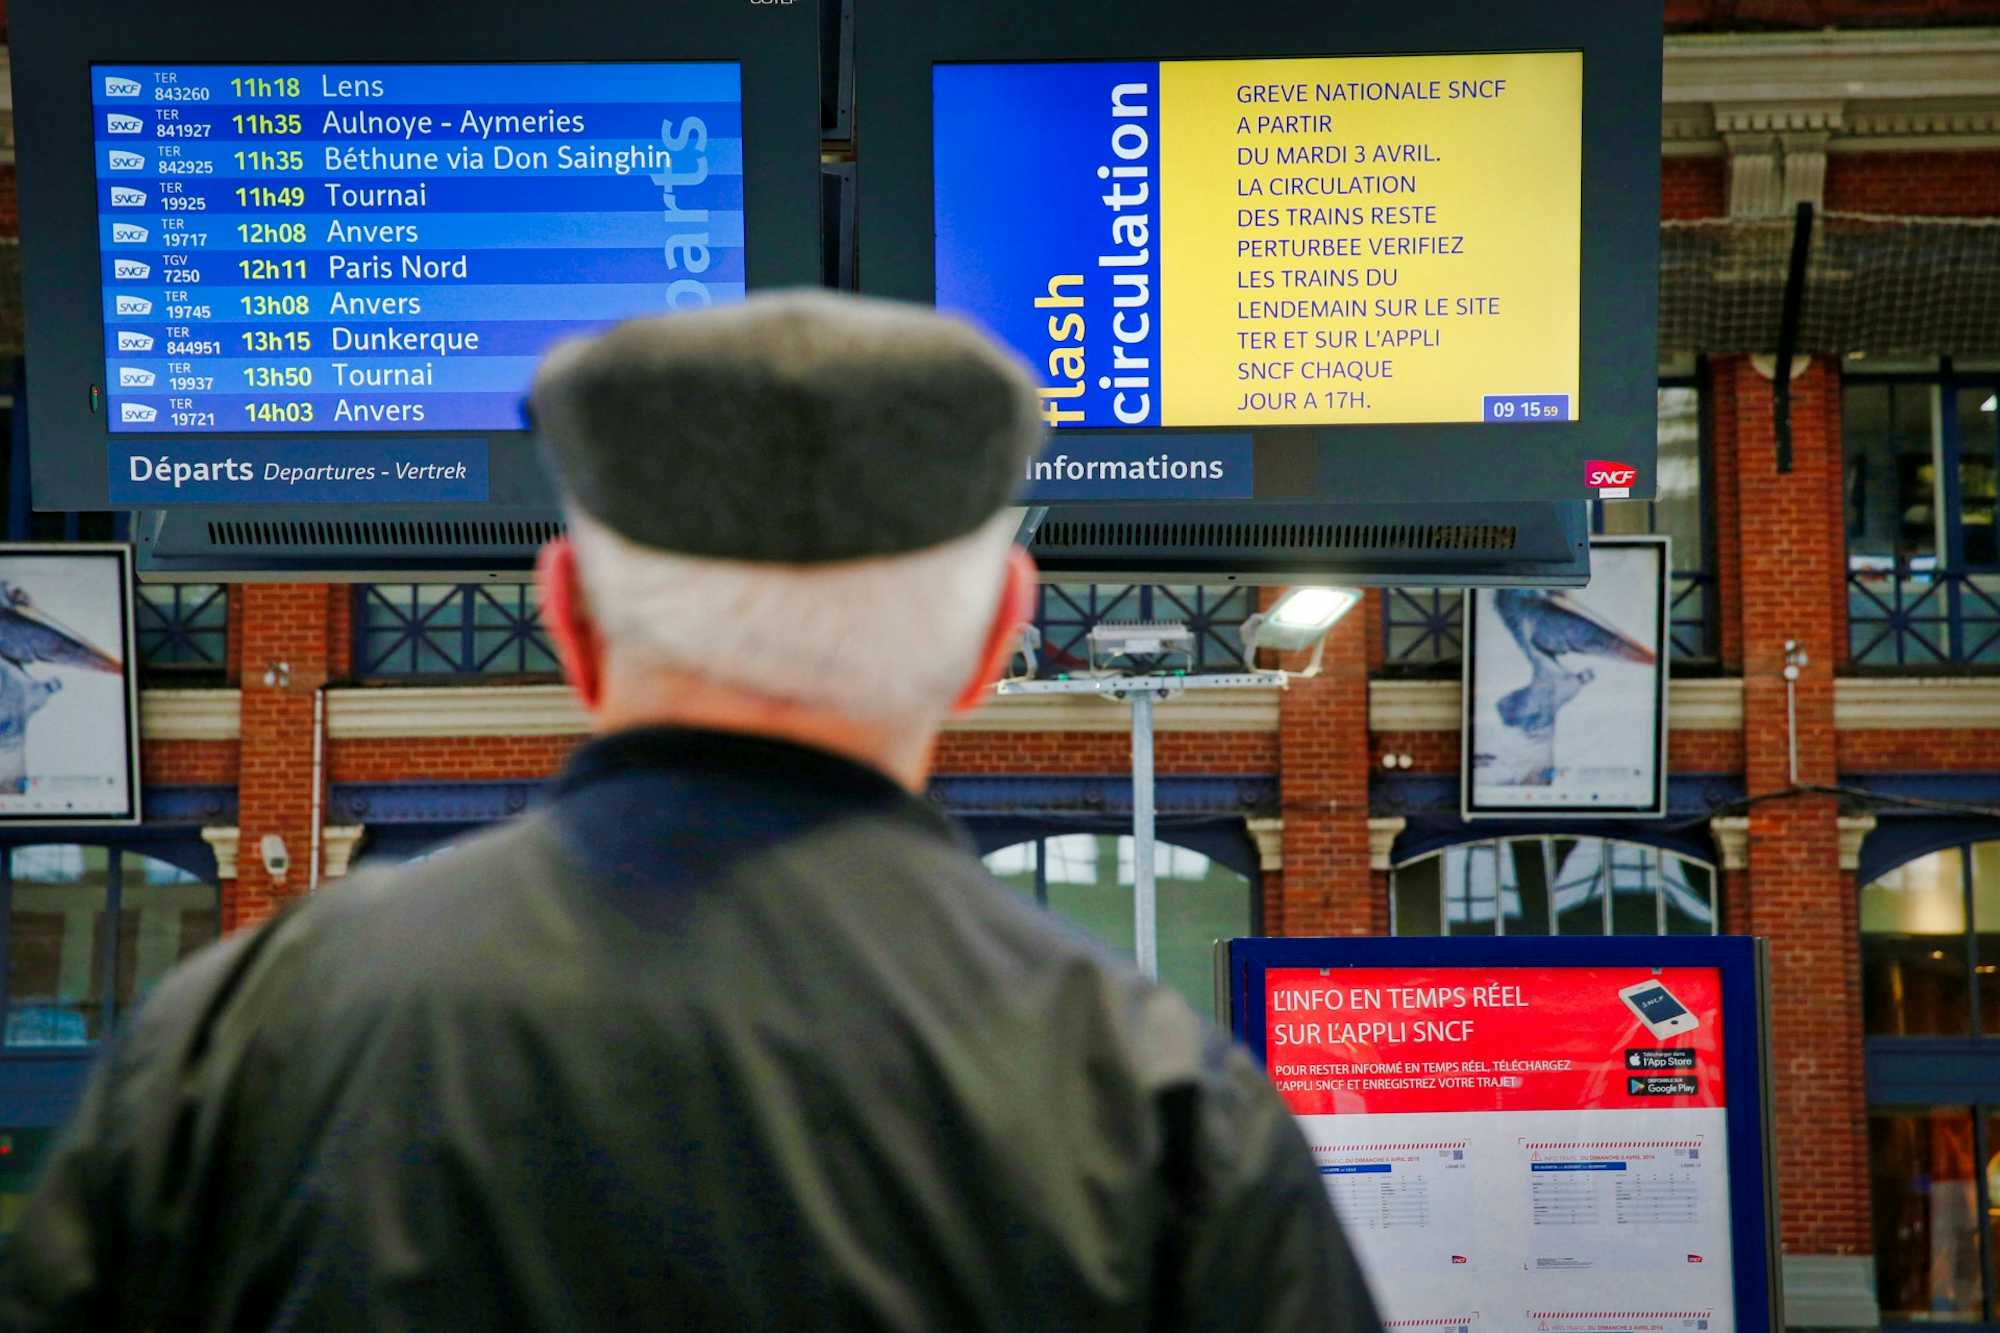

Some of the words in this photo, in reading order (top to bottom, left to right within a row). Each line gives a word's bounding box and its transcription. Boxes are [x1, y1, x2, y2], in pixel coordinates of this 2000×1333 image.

[154, 73, 176, 83] TER
[107, 82, 140, 95] SNCF
[231, 78, 300, 97] 11h18
[322, 74, 384, 97] Lens
[1237, 85, 1308, 103] GREVE
[1316, 82, 1440, 102] NATIONALE
[1449, 80, 1505, 98] SNCF
[155, 88, 209, 101] 843260
[156, 110, 178, 120] TER
[109, 119, 141, 132] SNCF
[157, 125, 211, 138] 841927
[232, 114, 301, 134] 11h35
[323, 111, 432, 139] Aulnoye
[460, 110, 585, 139] Aymeries
[1237, 117, 1250, 134] A
[1258, 115, 1332, 133] PARTIR
[158, 146, 181, 156] TER
[1238, 148, 1268, 165] DU
[1277, 146, 1346, 164] MARDI
[1354, 146, 1365, 163] 3
[1373, 144, 1440, 162] AVRIL.
[111, 156, 143, 169] SNCF
[234, 151, 303, 170] 11h35
[325, 146, 438, 170] Béthune
[448, 146, 484, 170] via
[494, 146, 547, 169] Don
[558, 145, 671, 174] Sainghin
[158, 161, 213, 174] 842925
[160, 183, 182, 193] TER
[1238, 178, 1262, 196] LA
[1270, 176, 1416, 196] CIRCULATION
[113, 192, 145, 205] SNCF
[235, 188, 304, 207] 11h49
[325, 183, 426, 206] Tournai
[161, 198, 206, 211] 19925
[1238, 208, 1279, 227] DES
[1287, 207, 1363, 226] TRAINS
[1372, 206, 1436, 224] RESTE
[161, 219, 184, 229] TER
[115, 228, 147, 242] SNCF
[237, 224, 306, 243] 12h08
[327, 220, 418, 242] Anvers
[163, 234, 207, 247] 19717
[1238, 238, 1361, 258] PERTURBEE
[1369, 237, 1463, 255] VERIFIEZ
[163, 255, 187, 266] TGV
[1097, 83, 1149, 424] circulation
[117, 265, 148, 278] SNCF
[239, 260, 307, 280] 12h11
[330, 256, 392, 279] Paris
[402, 255, 467, 278] Nord
[164, 270, 200, 283] 7250
[1238, 270, 1274, 288] LES
[1282, 269, 1359, 287] TRAINS
[1367, 268, 1397, 286] DU
[165, 291, 188, 301] TER
[118, 301, 150, 314] SNCF
[240, 296, 309, 315] 13h08
[330, 292, 421, 315] Anvers
[1238, 299, 1366, 319] LENDEMAIN
[1375, 299, 1417, 317] SUR
[1425, 298, 1448, 316] LE
[1456, 297, 1500, 315] SITE
[166, 306, 211, 319] 19745
[166, 327, 189, 337] TER
[1237, 331, 1276, 349] TER
[1284, 331, 1308, 348] ET
[1315, 330, 1357, 348] SUR
[1365, 329, 1440, 348] L'APPLI
[120, 337, 152, 350] SNCF
[167, 342, 220, 355] 844951
[242, 332, 310, 351] 13h15
[333, 328, 479, 356] Dunkerque
[1034, 274, 1086, 426] flash
[168, 363, 190, 373] TER
[244, 368, 312, 387] 13h50
[332, 363, 432, 386] Tournai
[1238, 362, 1295, 380] SNCF
[1301, 360, 1392, 382] CHAQUE
[122, 373, 153, 385] SNCF
[169, 378, 213, 390] 19937
[169, 399, 192, 409] TER
[1238, 392, 1297, 410] JOUR
[1304, 392, 1317, 409] A
[1325, 391, 1371, 409] 17H.
[124, 408, 155, 421] SNCF
[245, 403, 313, 422] 14h03
[334, 399, 424, 421] Anvers
[1494, 402, 1514, 418] 09
[1521, 402, 1540, 417] 15
[1543, 406, 1558, 417] 59
[171, 413, 214, 426] 19721
[130, 455, 253, 487] Départs
[264, 462, 375, 485] Departures
[396, 461, 466, 480] Vertrek
[1026, 455, 1224, 480] Informations
[1587, 466, 1637, 486] SNCF
[1273, 989, 1343, 1011] L'INFO
[1351, 988, 1380, 1010] EN
[1387, 987, 1466, 1009] TEMPS
[1473, 982, 1528, 1007] RÉEL
[1275, 1024, 1320, 1045] SUR
[1328, 1022, 1406, 1044] L'APPLI
[1413, 1020, 1474, 1042] SNCF
[1276, 1064, 1307, 1076] POUR
[1310, 1064, 1349, 1075] RESTER
[1352, 1062, 1402, 1074] INFORMÉ
[1405, 1063, 1420, 1073] EN
[1422, 1062, 1459, 1073] TEMPS
[1492, 1059, 1572, 1071] TÉLÉCHARGEZ
[1643, 1058, 1665, 1068] l'App
[1668, 1057, 1692, 1066] Store
[1276, 1081, 1312, 1092] L'APPLI
[1316, 1080, 1344, 1090] SNCF
[1347, 1080, 1360, 1090] ET
[1363, 1078, 1436, 1089] ENREGISTREZ
[1438, 1077, 1475, 1088] VOTRE
[1478, 1076, 1516, 1088] TRAJET
[1648, 1084, 1677, 1094] Google
[1679, 1084, 1695, 1093] Play
